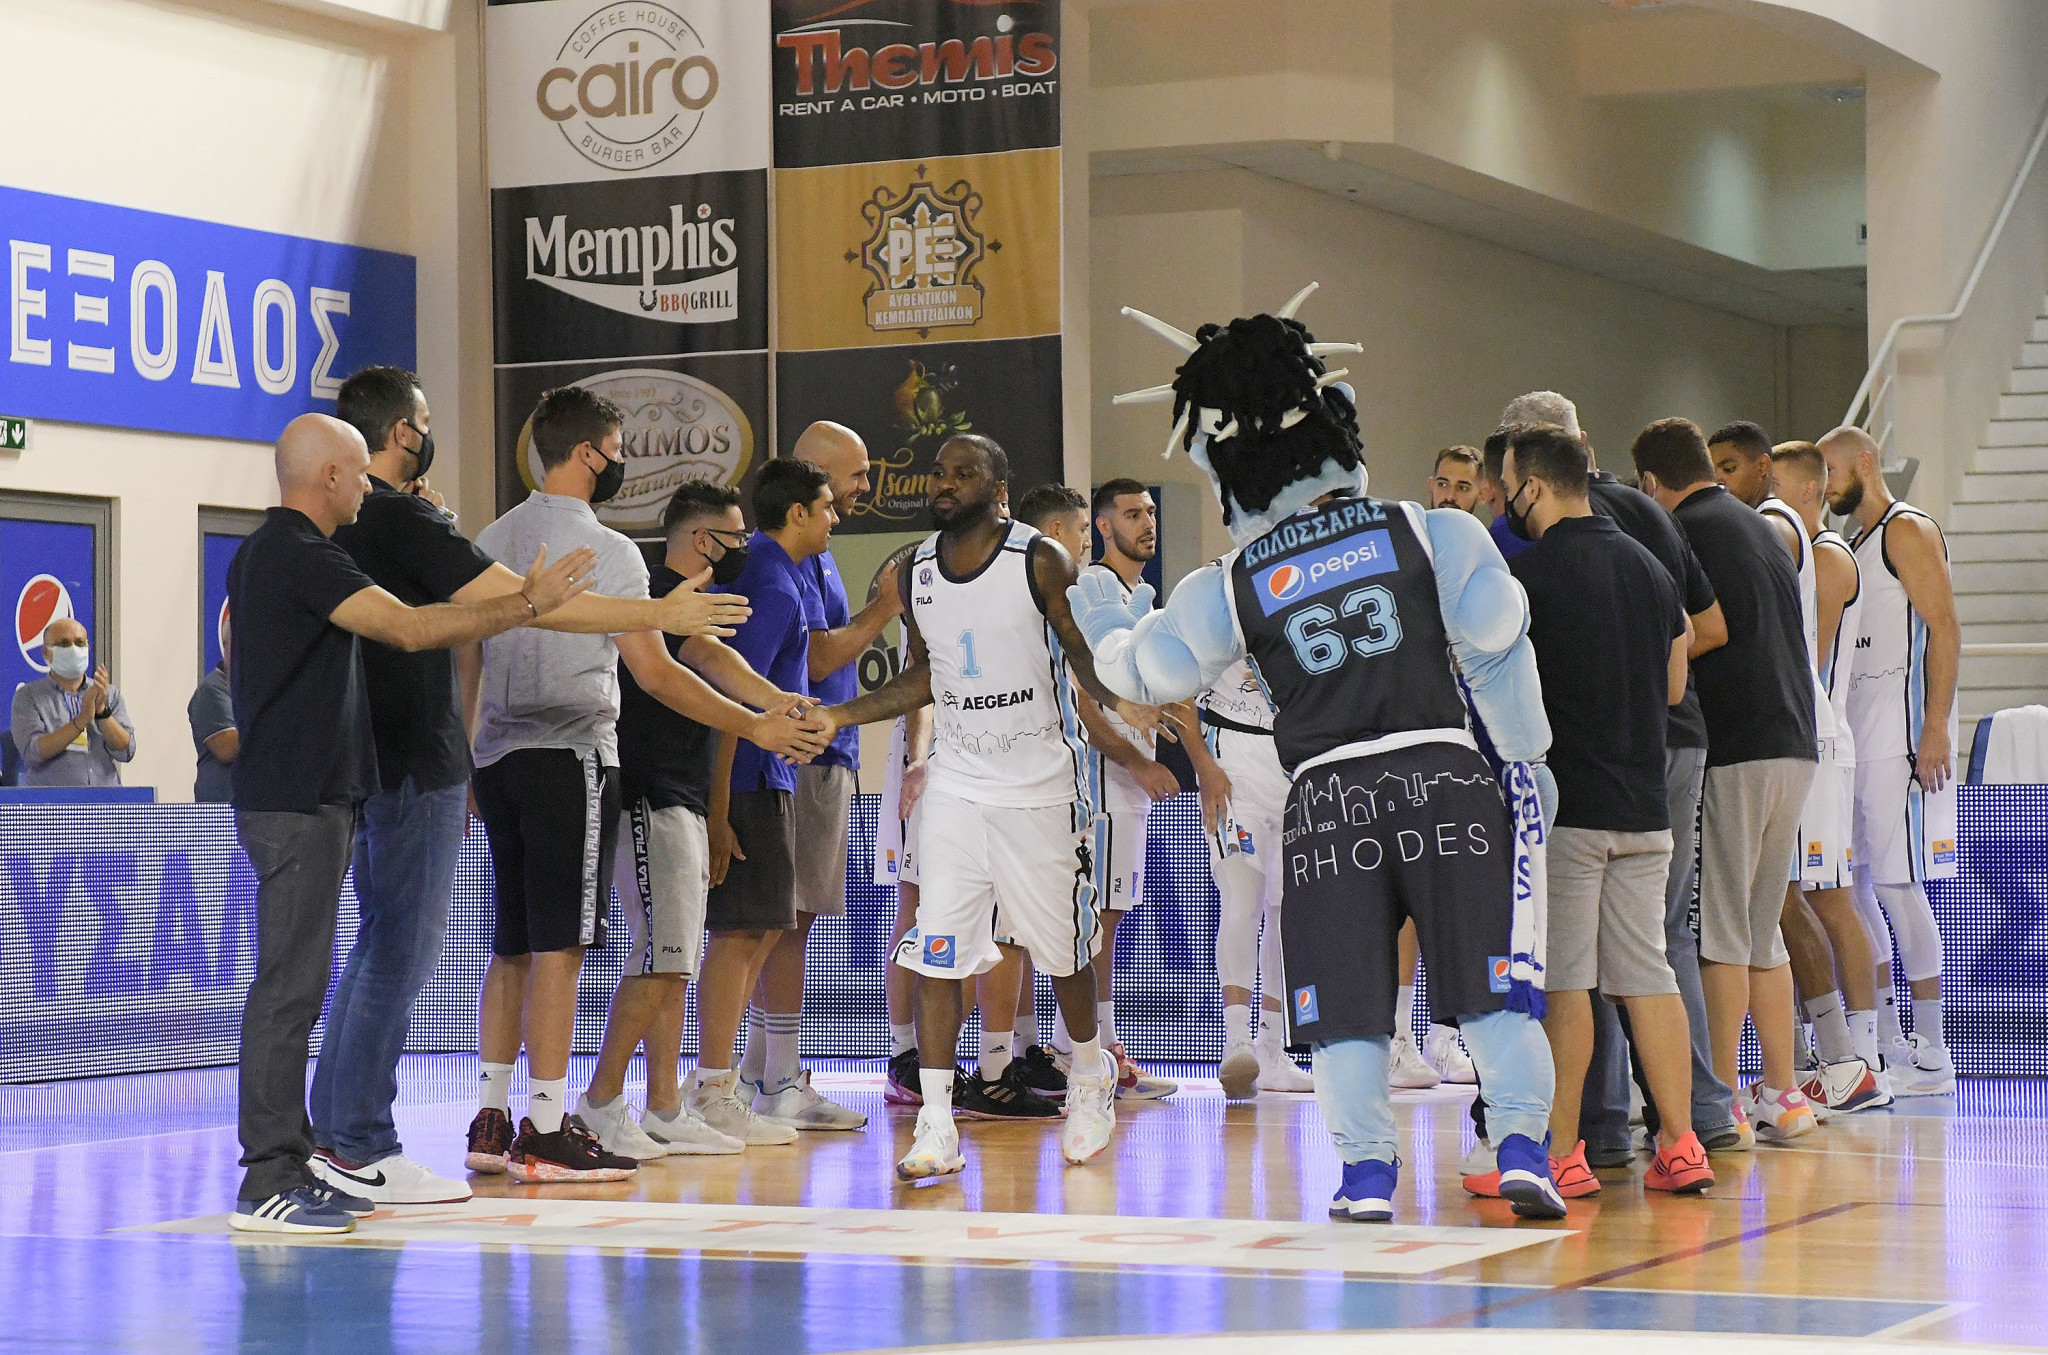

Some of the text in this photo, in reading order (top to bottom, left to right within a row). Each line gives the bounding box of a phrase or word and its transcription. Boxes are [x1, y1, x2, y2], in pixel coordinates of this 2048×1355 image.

[572, 10, 688, 53] COFFEE HOUSE
[776, 14, 1057, 96] Themis
[536, 40, 719, 122] cairo
[779, 80, 1058, 116] RENT A CAR MOTO BOAT
[581, 126, 684, 163] BURGER BAR
[524, 203, 738, 301] Memphis
[9, 239, 351, 400] ΕΞΟΔΟΣ
[621, 423, 731, 459] RIMOS
[888, 497, 924, 509] Original
[1245, 501, 1388, 569] ΚΟΛΟΣΣΑΡΑΣ
[1309, 540, 1379, 584] pepsi
[916, 596, 933, 606] FILA
[1284, 584, 1404, 675] 63
[1855, 636, 1872, 649] AN
[957, 628, 982, 678] 1
[962, 687, 1034, 710] AEGEAN
[1293, 823, 1490, 887] RHODES
[1114, 877, 1122, 894] FILA
